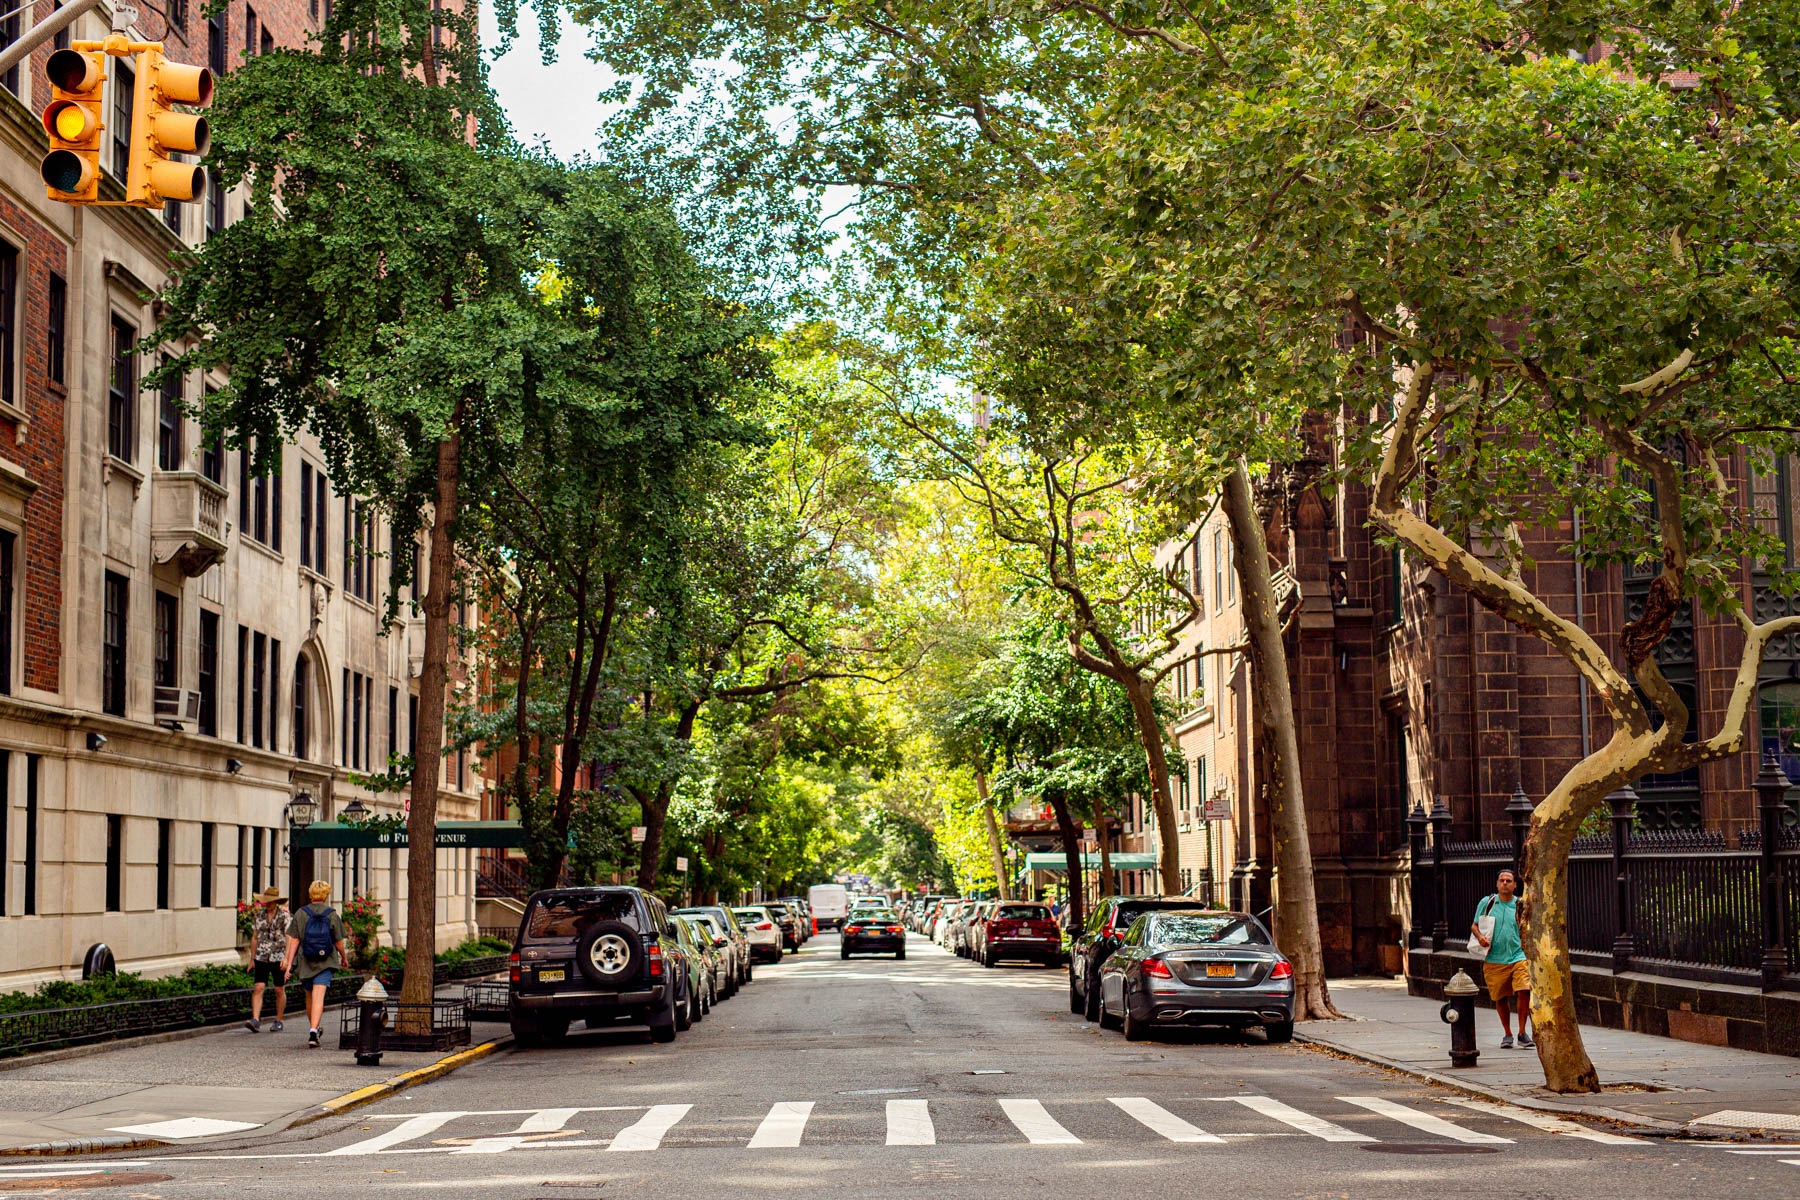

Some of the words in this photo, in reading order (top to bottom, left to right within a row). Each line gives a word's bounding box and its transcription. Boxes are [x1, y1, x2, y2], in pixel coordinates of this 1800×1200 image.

[296, 806, 308, 814] 40
[378, 833, 390, 843] 40
[435, 833, 467, 843] VENUE
